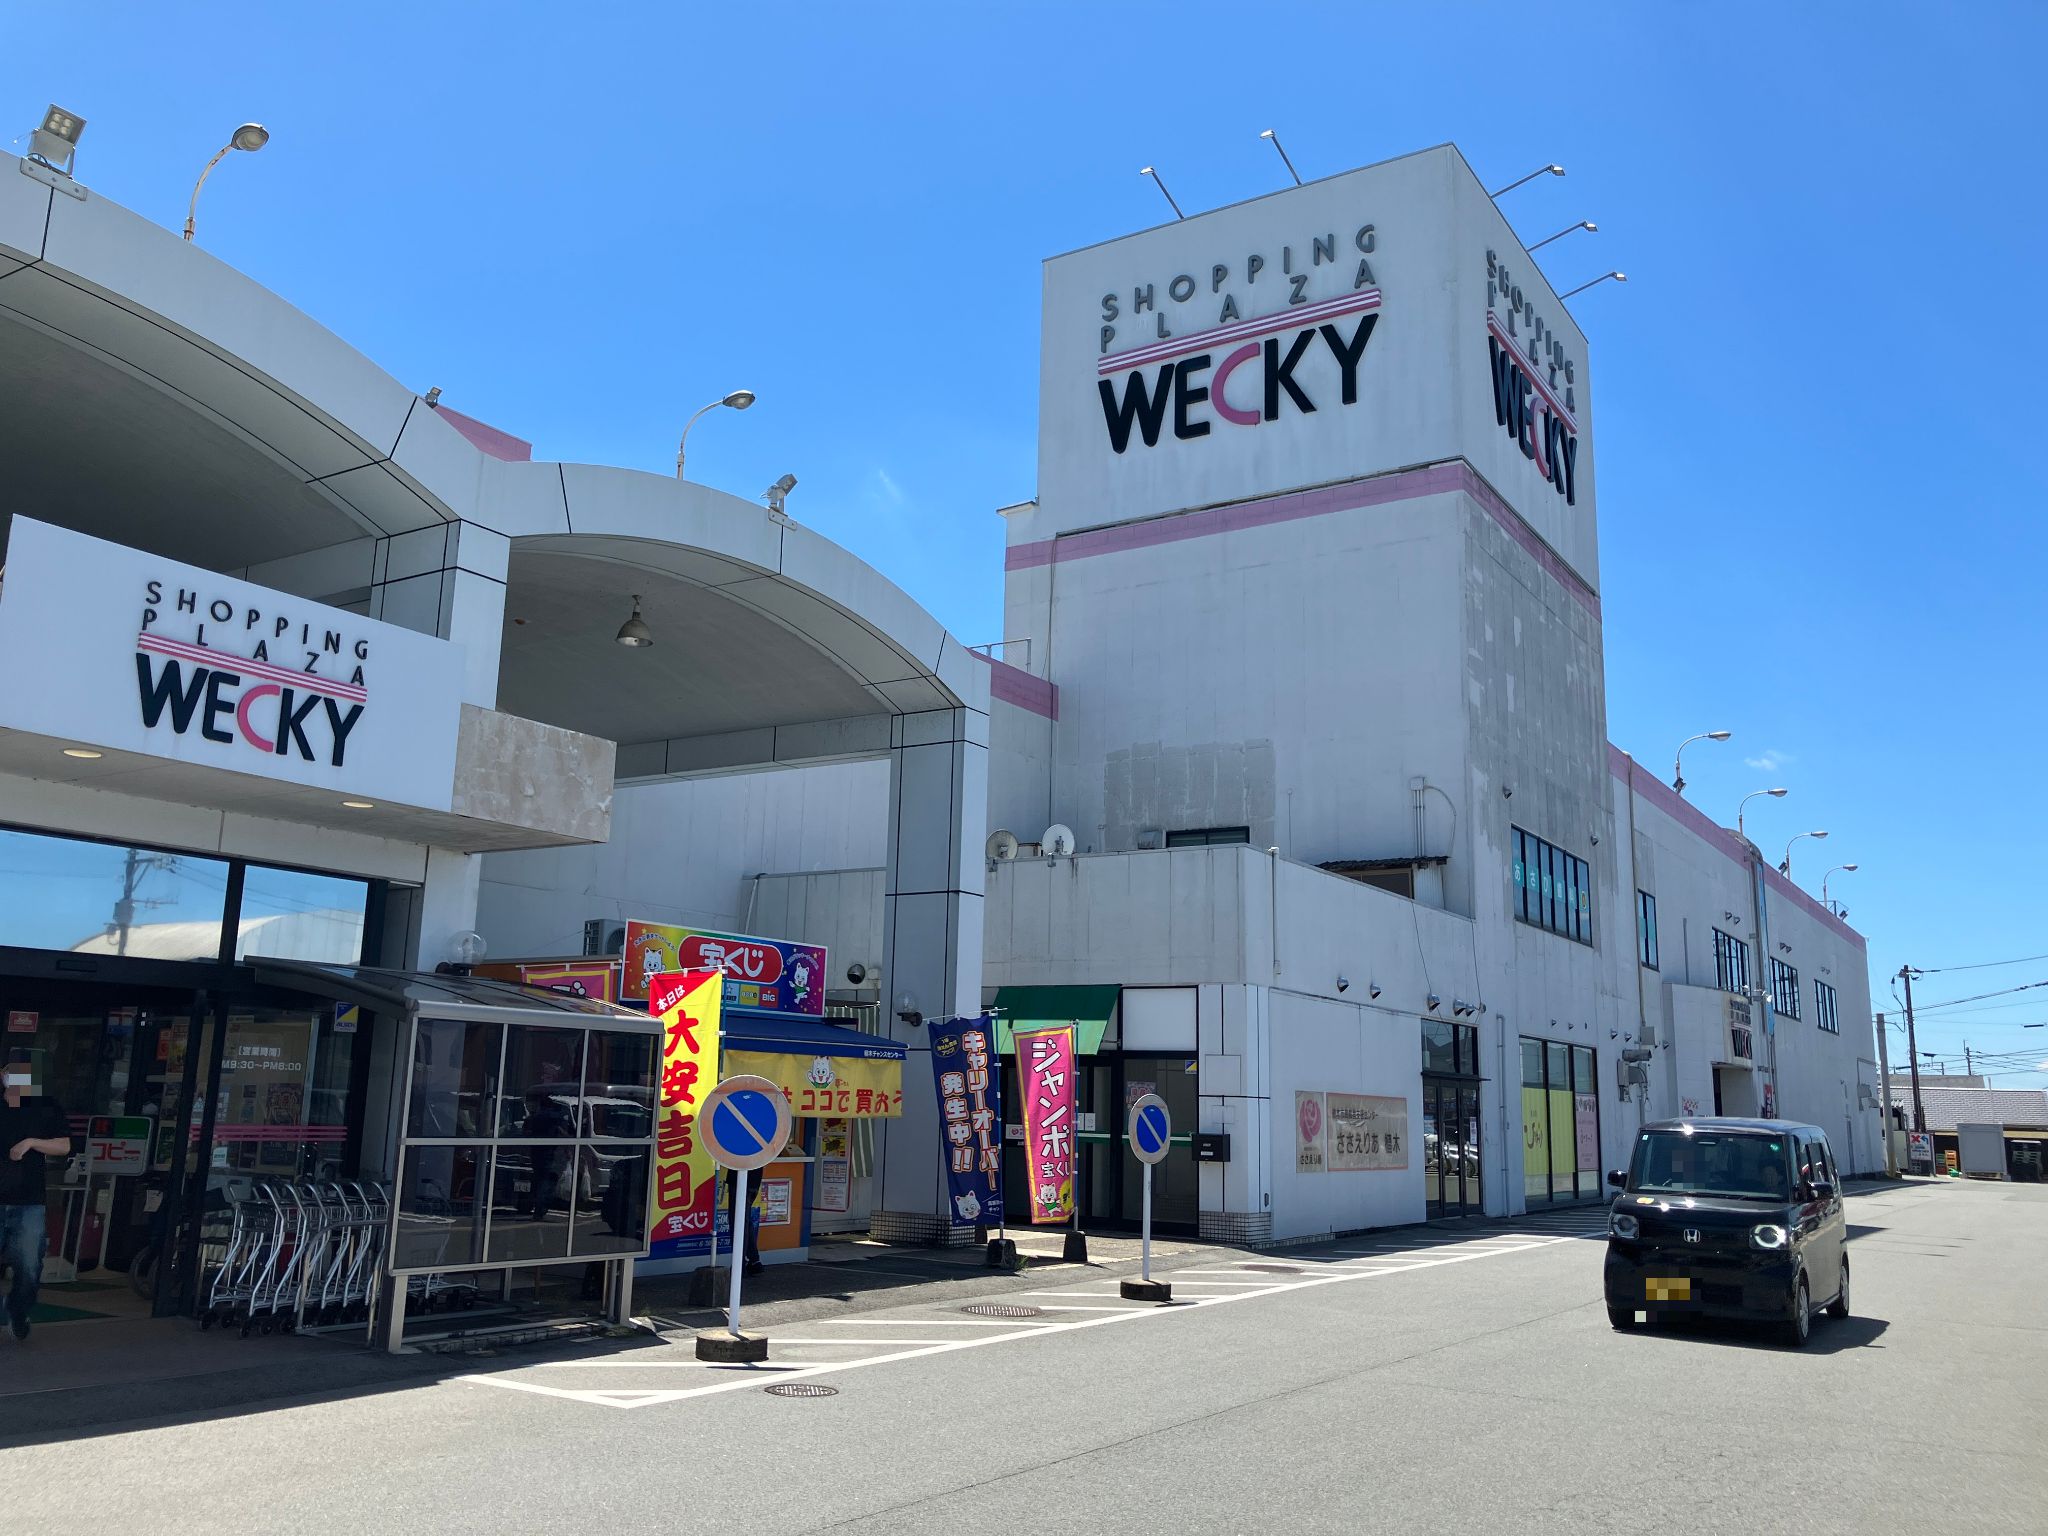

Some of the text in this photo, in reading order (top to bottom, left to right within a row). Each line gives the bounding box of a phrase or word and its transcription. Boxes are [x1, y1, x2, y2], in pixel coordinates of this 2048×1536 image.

[1101, 224, 1375, 322] SHOPPING
[1101, 258, 1376, 353] PLAZA
[1487, 249, 1574, 385] SHOPPING
[1098, 313, 1379, 454] WECKY
[1488, 336, 1578, 506] WECKY
[142, 608, 364, 687] PLAZA
[146, 581, 369, 660] SHOPPING
[136, 652, 365, 768] WECKY
[656, 985, 686, 1011] 本日は
[700, 943, 764, 978] 宝くじ
[656, 1009, 700, 1210] 大安吉日
[962, 1031, 1000, 1191] キャリーオーバー
[1032, 1038, 1070, 1158] ジャンボ
[1337, 1132, 1380, 1154] ささえりあ
[91, 1141, 140, 1161] コピー
[668, 1211, 708, 1234] 宝くじ
